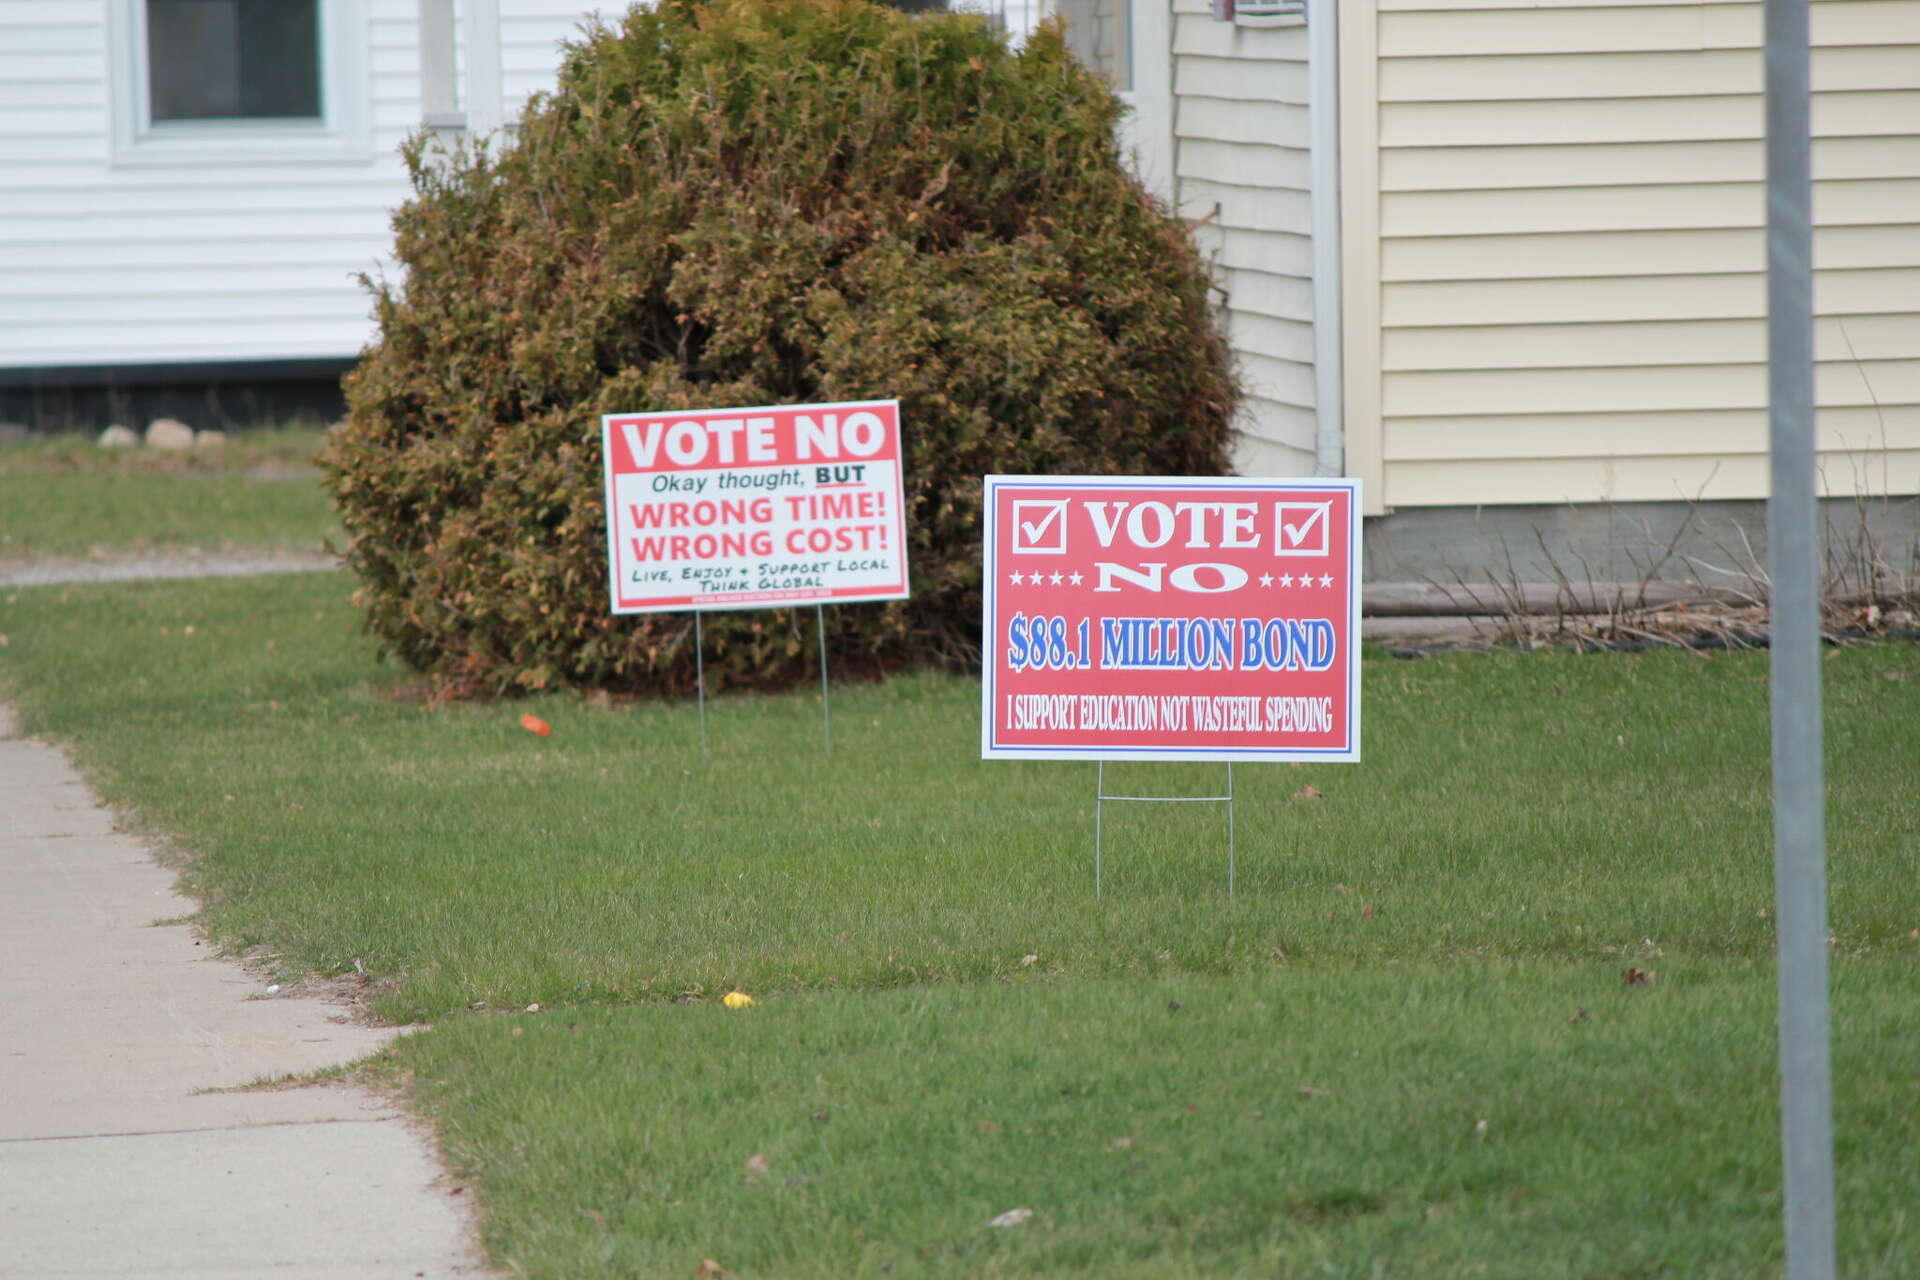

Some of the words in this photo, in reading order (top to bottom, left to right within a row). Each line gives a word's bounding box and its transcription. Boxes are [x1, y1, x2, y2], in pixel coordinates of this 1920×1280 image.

[621, 417, 778, 468] VOTE
[794, 411, 886, 460] NO
[652, 474, 707, 494] Okay
[718, 468, 805, 491] thought,
[815, 465, 866, 484] BUT
[629, 497, 773, 530] WRONG
[784, 491, 886, 521] TIME!
[1083, 500, 1261, 548] VOTE
[630, 530, 773, 562] WRONG
[786, 525, 888, 554] COST!
[1094, 562, 1249, 593] NO
[1008, 611, 1091, 673] $88.1
[1100, 616, 1235, 671] MILLION
[1240, 617, 1336, 672] BOND
[1006, 694, 1013, 730] I
[1015, 694, 1078, 730] SUPPORT
[1080, 695, 1158, 731] EDUCATION
[1160, 695, 1189, 731] NOT
[1191, 695, 1264, 732] WASTEFUL
[1265, 696, 1333, 733] SPENDING
